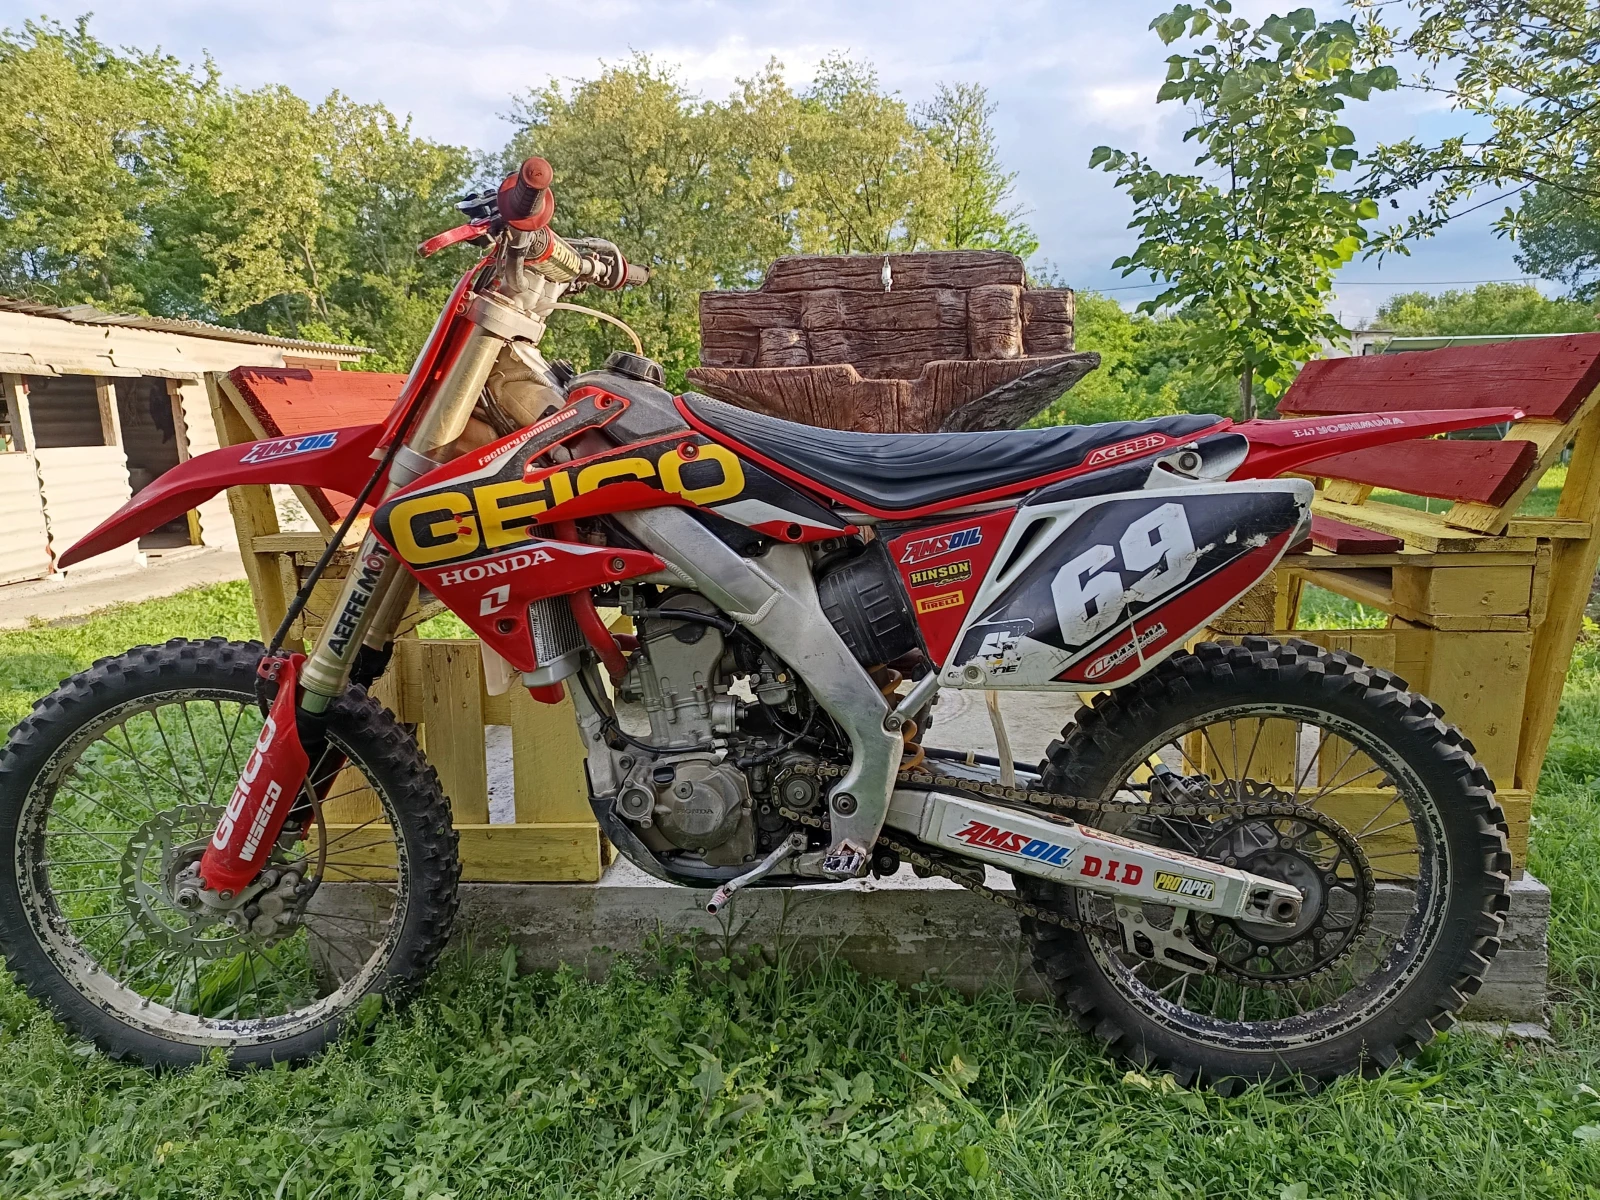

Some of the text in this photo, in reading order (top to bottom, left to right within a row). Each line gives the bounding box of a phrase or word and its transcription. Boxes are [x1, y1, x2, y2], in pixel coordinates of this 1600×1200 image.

[478, 408, 578, 467] Factory Connection
[1316, 417, 1405, 435] YOSHIMURA
[242, 432, 338, 463] AMSOIL
[900, 527, 982, 564] AMSOIL
[438, 549, 556, 587] HONDA
[910, 562, 970, 584] HINSON
[1050, 502, 1197, 646] 69
[920, 593, 961, 611] PIRELLI
[212, 714, 277, 851] GEICO
[677, 807, 715, 815] HONDA
[954, 819, 1075, 867] AMSOIL
[1080, 855, 1144, 886] D.I.D
[1155, 871, 1215, 900] PROTAPER
